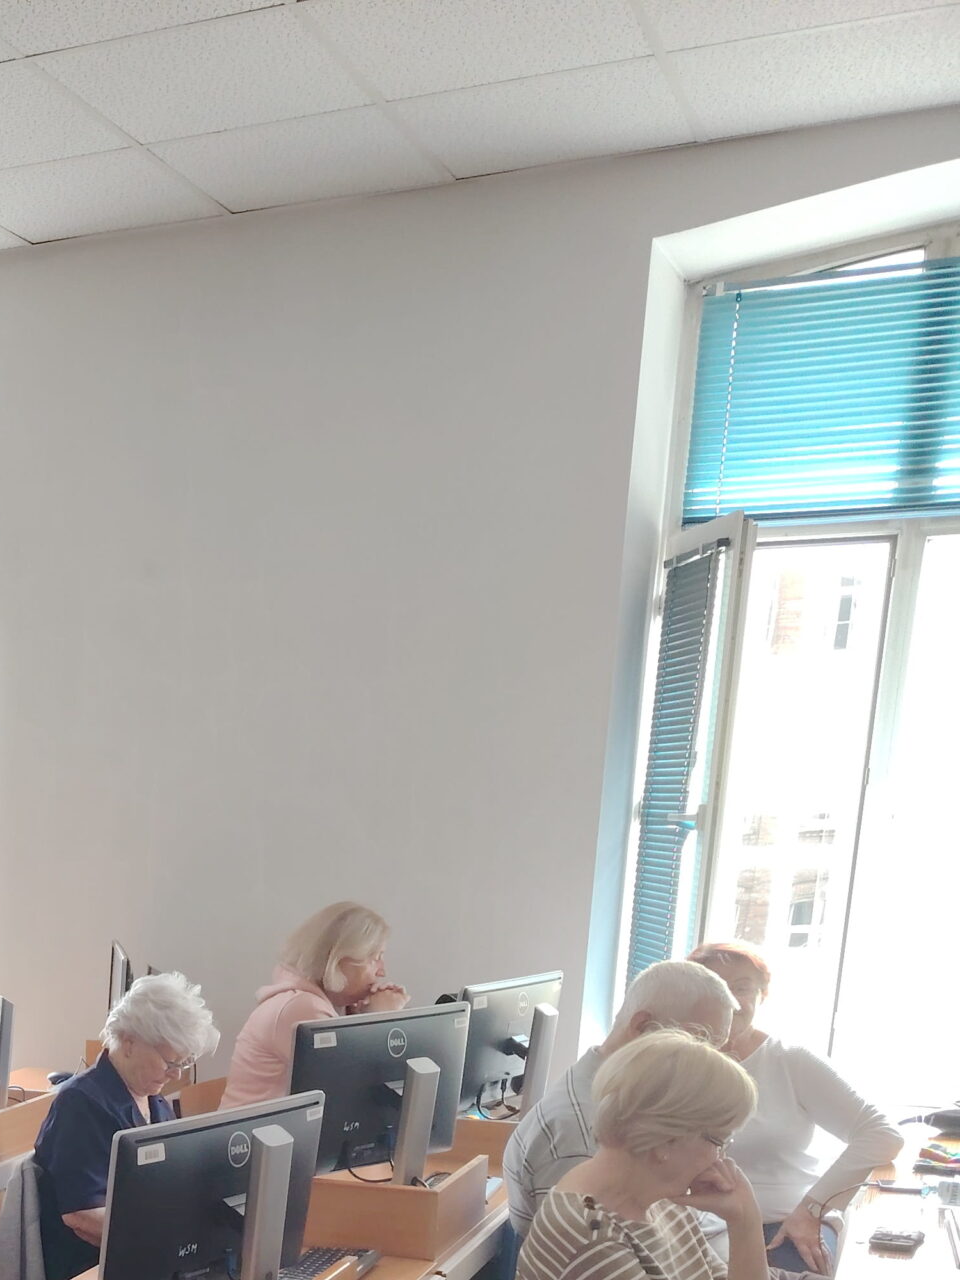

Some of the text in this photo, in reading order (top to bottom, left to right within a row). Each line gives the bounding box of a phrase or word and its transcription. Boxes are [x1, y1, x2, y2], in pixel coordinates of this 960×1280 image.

[390, 1038, 405, 1048] DELL
[230, 1143, 249, 1156] DELL
[179, 1243, 198, 1257] WSM
